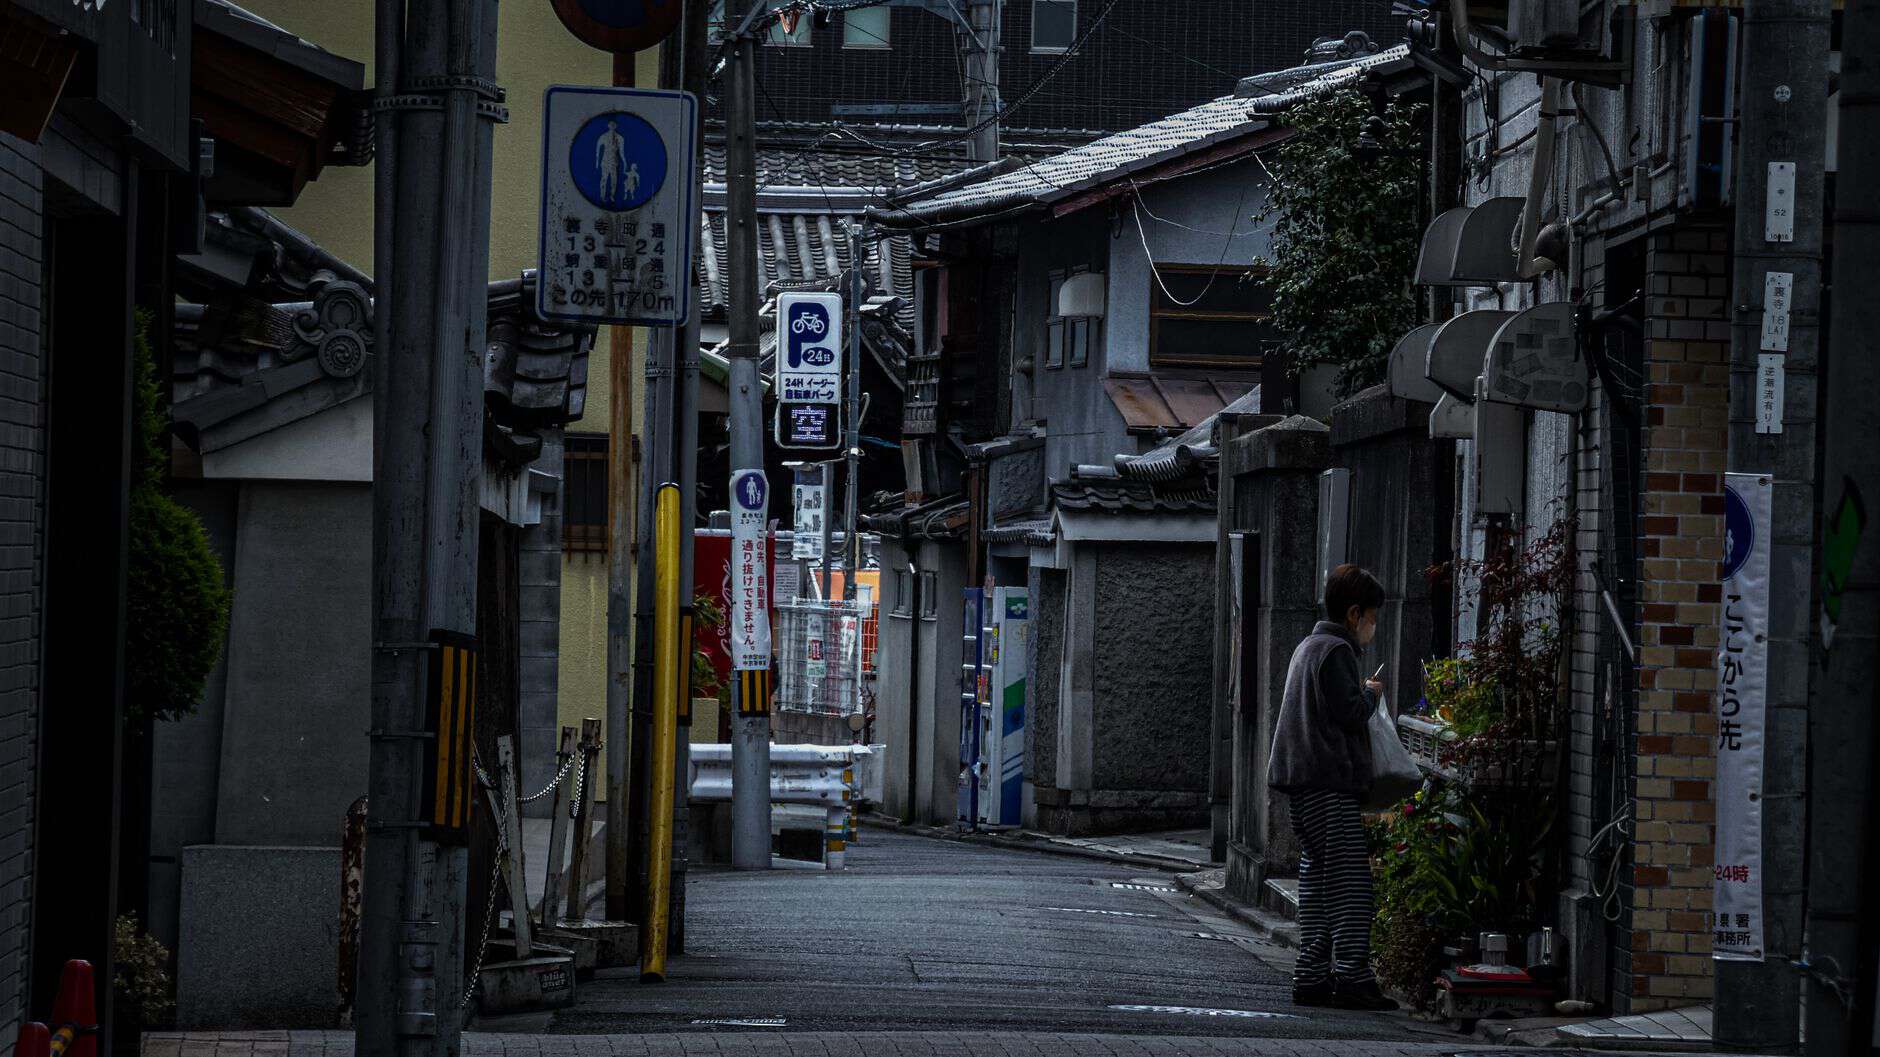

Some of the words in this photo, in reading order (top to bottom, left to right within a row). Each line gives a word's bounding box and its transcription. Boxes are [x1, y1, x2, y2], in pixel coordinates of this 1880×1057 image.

[785, 378, 803, 388] 24H
[806, 378, 835, 388] イージー
[785, 389, 835, 400] 自転車パーク
[742, 539, 755, 651] 通り抜けできません。
[1719, 594, 1743, 750] ここから先
